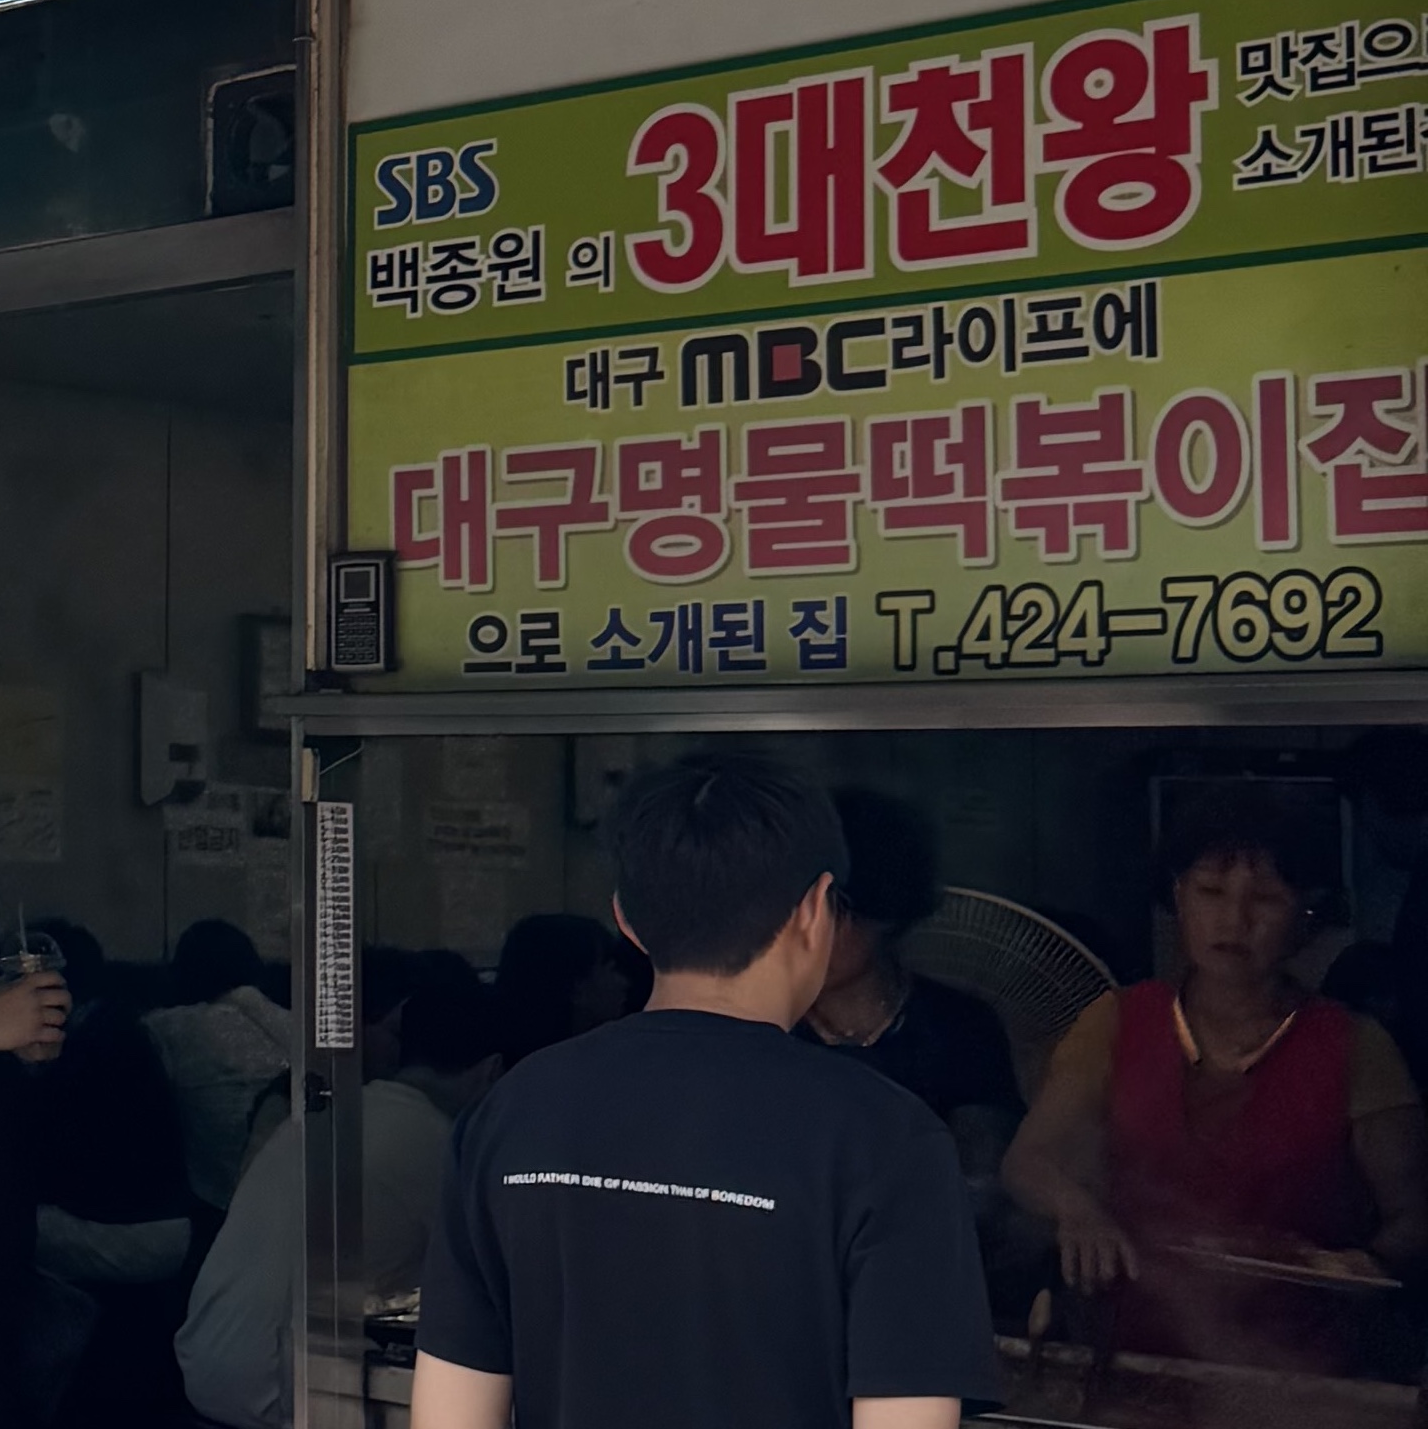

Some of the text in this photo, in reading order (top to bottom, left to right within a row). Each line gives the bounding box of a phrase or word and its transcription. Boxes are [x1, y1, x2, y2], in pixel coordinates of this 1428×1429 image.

[1236, 13, 1428, 108] 맛집으
[372, 138, 498, 231] SBS
[625, 12, 1219, 294] 3대천왕
[1233, 102, 1428, 192] 소개된
[368, 227, 617, 319] 백종원 의
[563, 343, 669, 415] 대구
[388, 365, 1428, 595] 대구명물떡볶이집
[461, 609, 569, 678] 으로
[586, 595, 768, 676] 소개된
[787, 594, 851, 674] 집
[537, 1173, 580, 1186] RATHER
[581, 1175, 602, 1188] DIE
[603, 1178, 620, 1189] OF
[621, 1179, 669, 1195] PASSION
[670, 1184, 694, 1198] THAN
[694, 1187, 710, 1199] OF
[710, 1189, 776, 1211] BOREDOM
